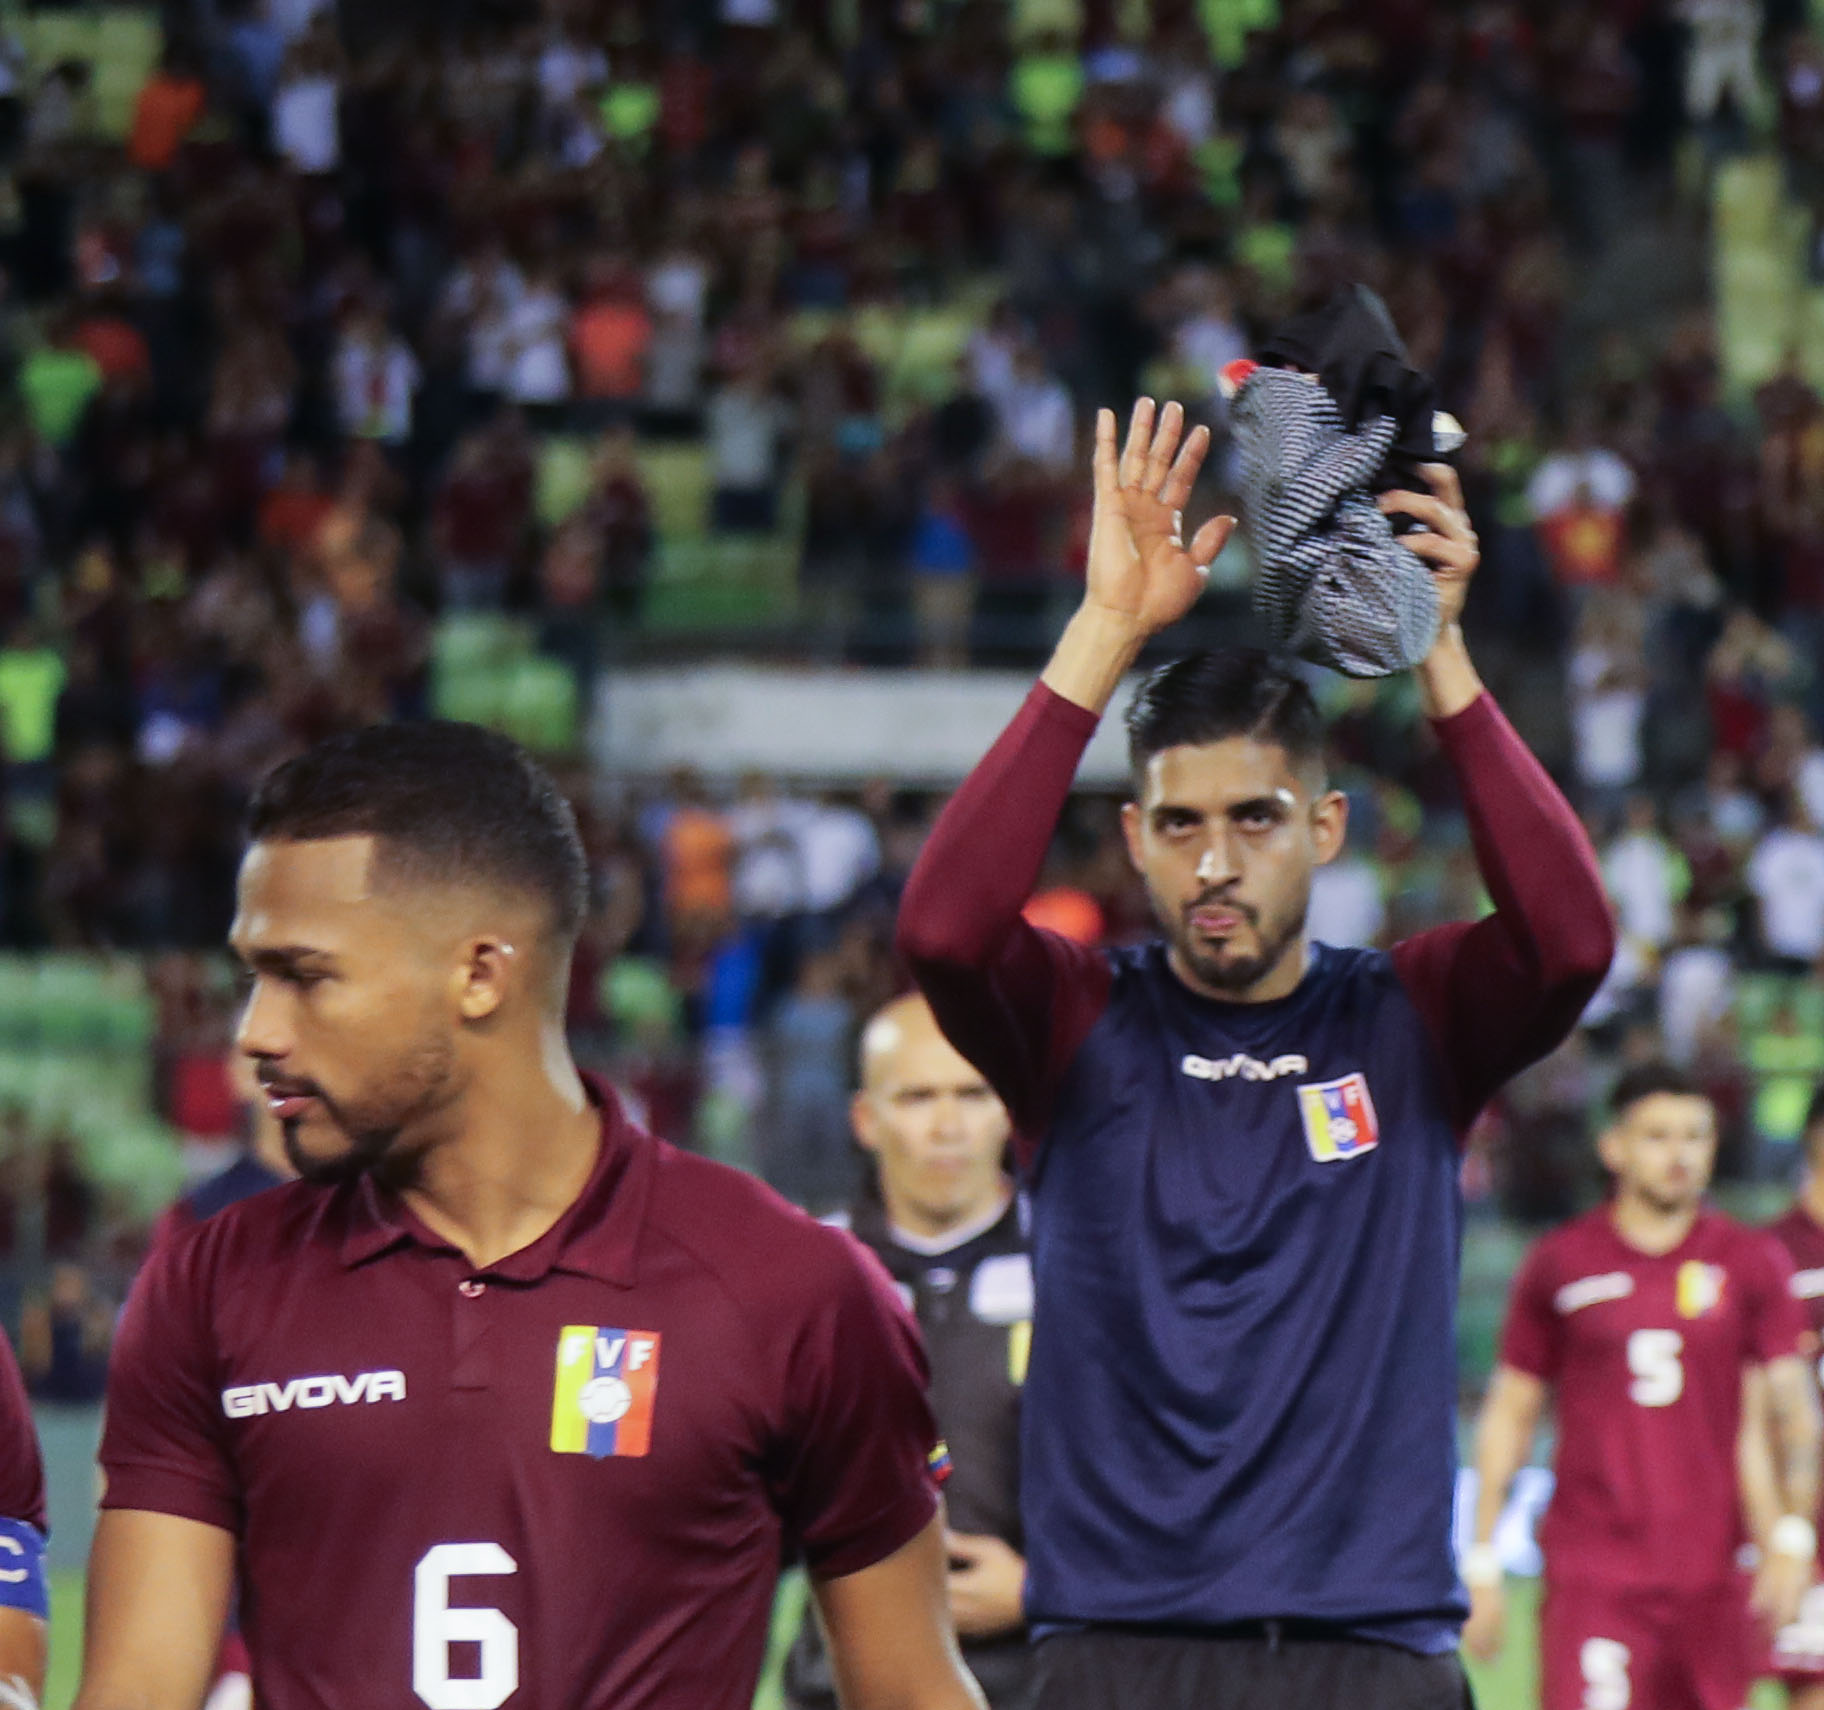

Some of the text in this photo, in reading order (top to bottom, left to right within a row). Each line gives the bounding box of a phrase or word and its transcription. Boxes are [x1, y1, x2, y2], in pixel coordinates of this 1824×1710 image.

[560, 1334, 656, 1372] FVF
[1627, 1328, 1685, 1409] 5
[222, 1371, 407, 1419] GIVOVA
